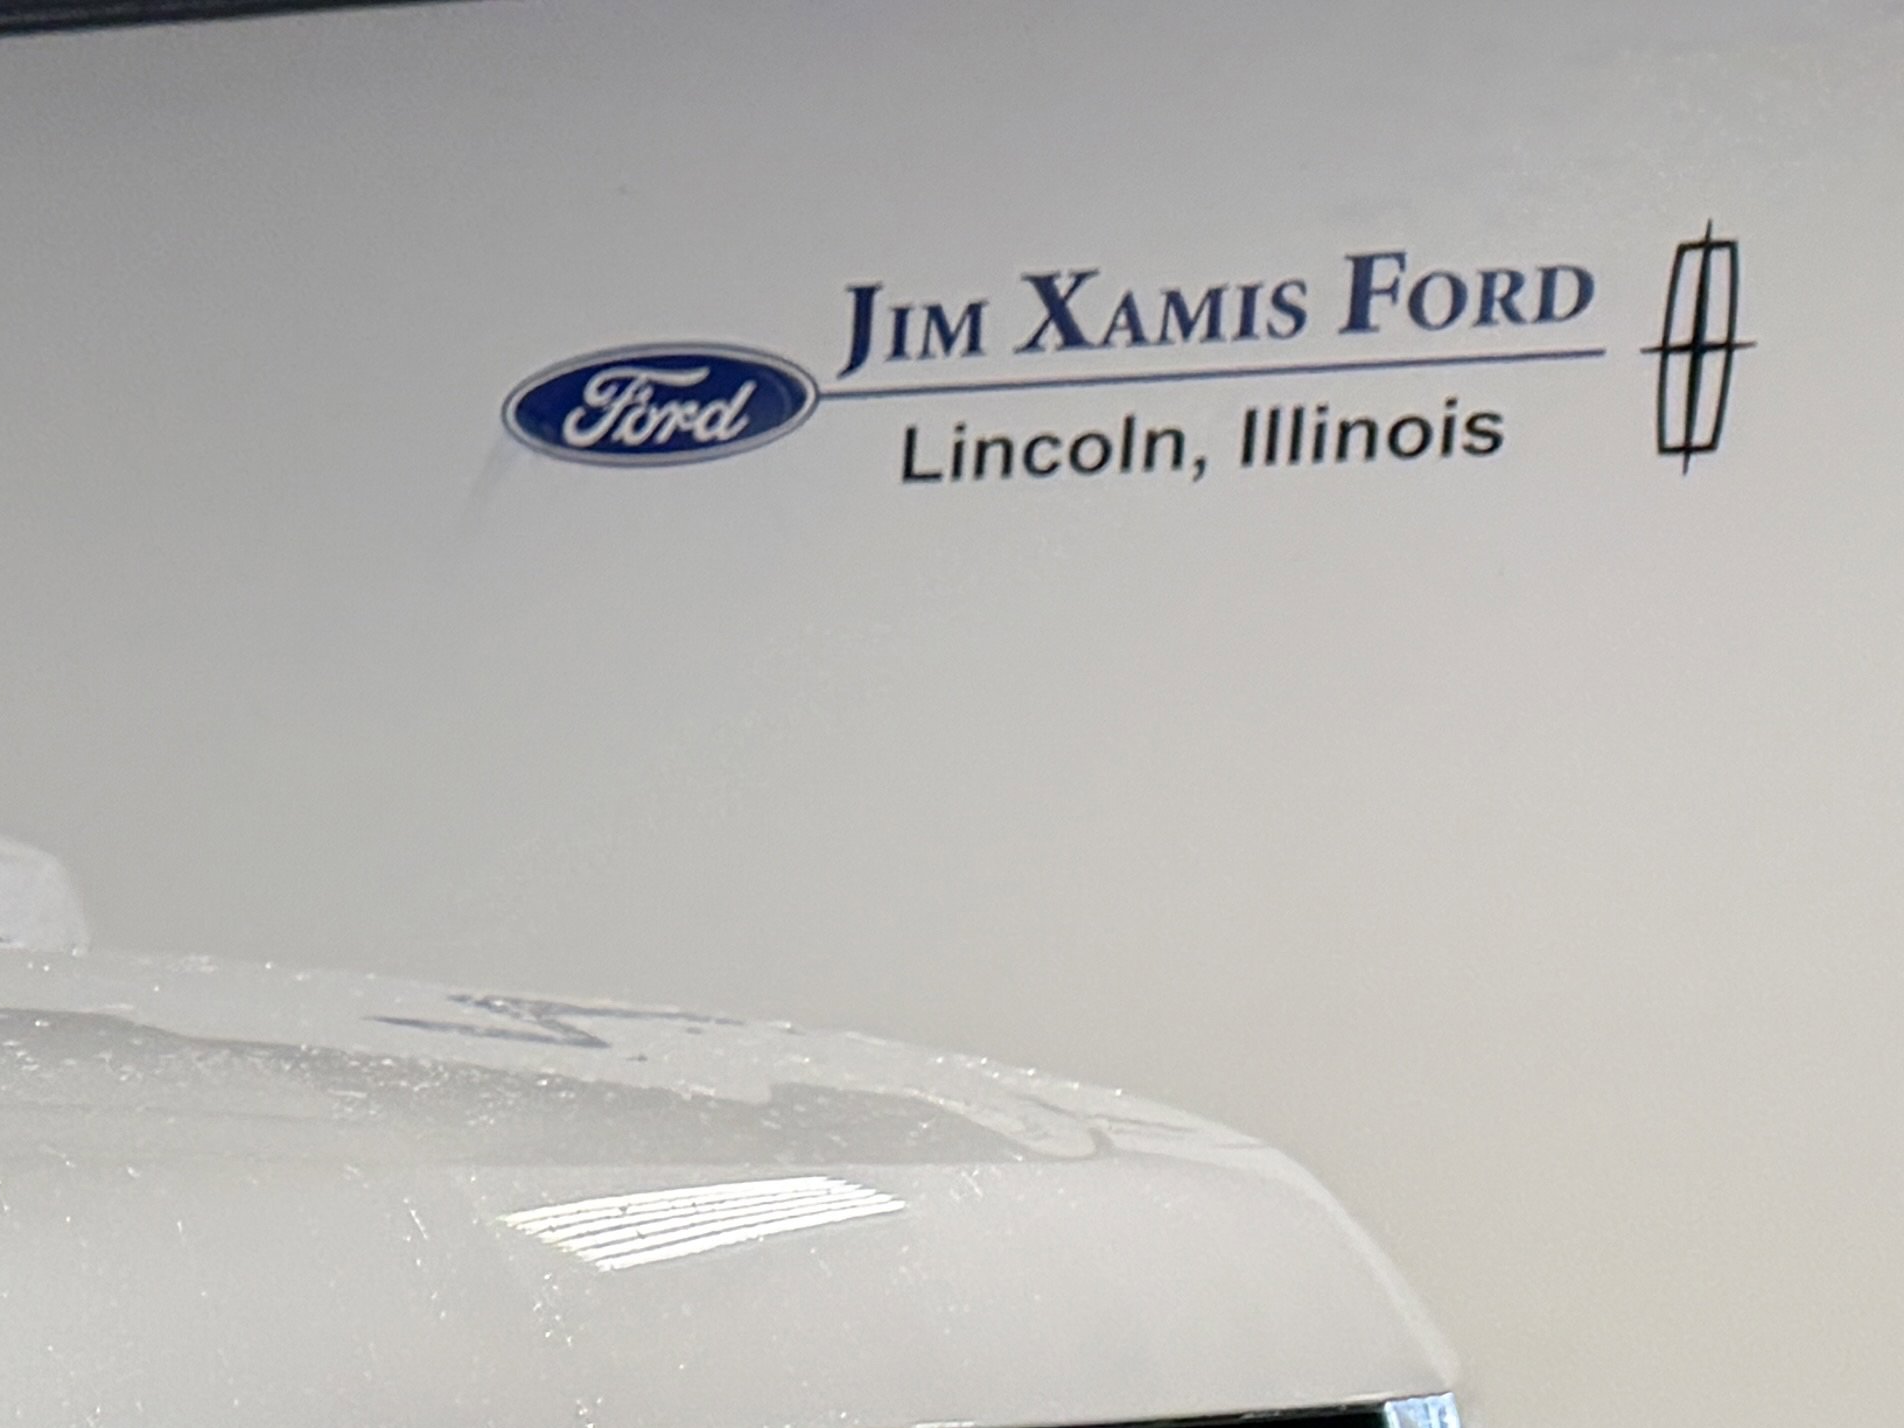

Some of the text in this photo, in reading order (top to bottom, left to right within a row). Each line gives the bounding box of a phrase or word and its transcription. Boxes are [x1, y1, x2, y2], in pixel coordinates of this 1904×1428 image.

[837, 249, 1596, 380] JIM XAMIS FORD
[562, 365, 758, 448] Ford
[901, 396, 1505, 483] Lincoln, Illinois
